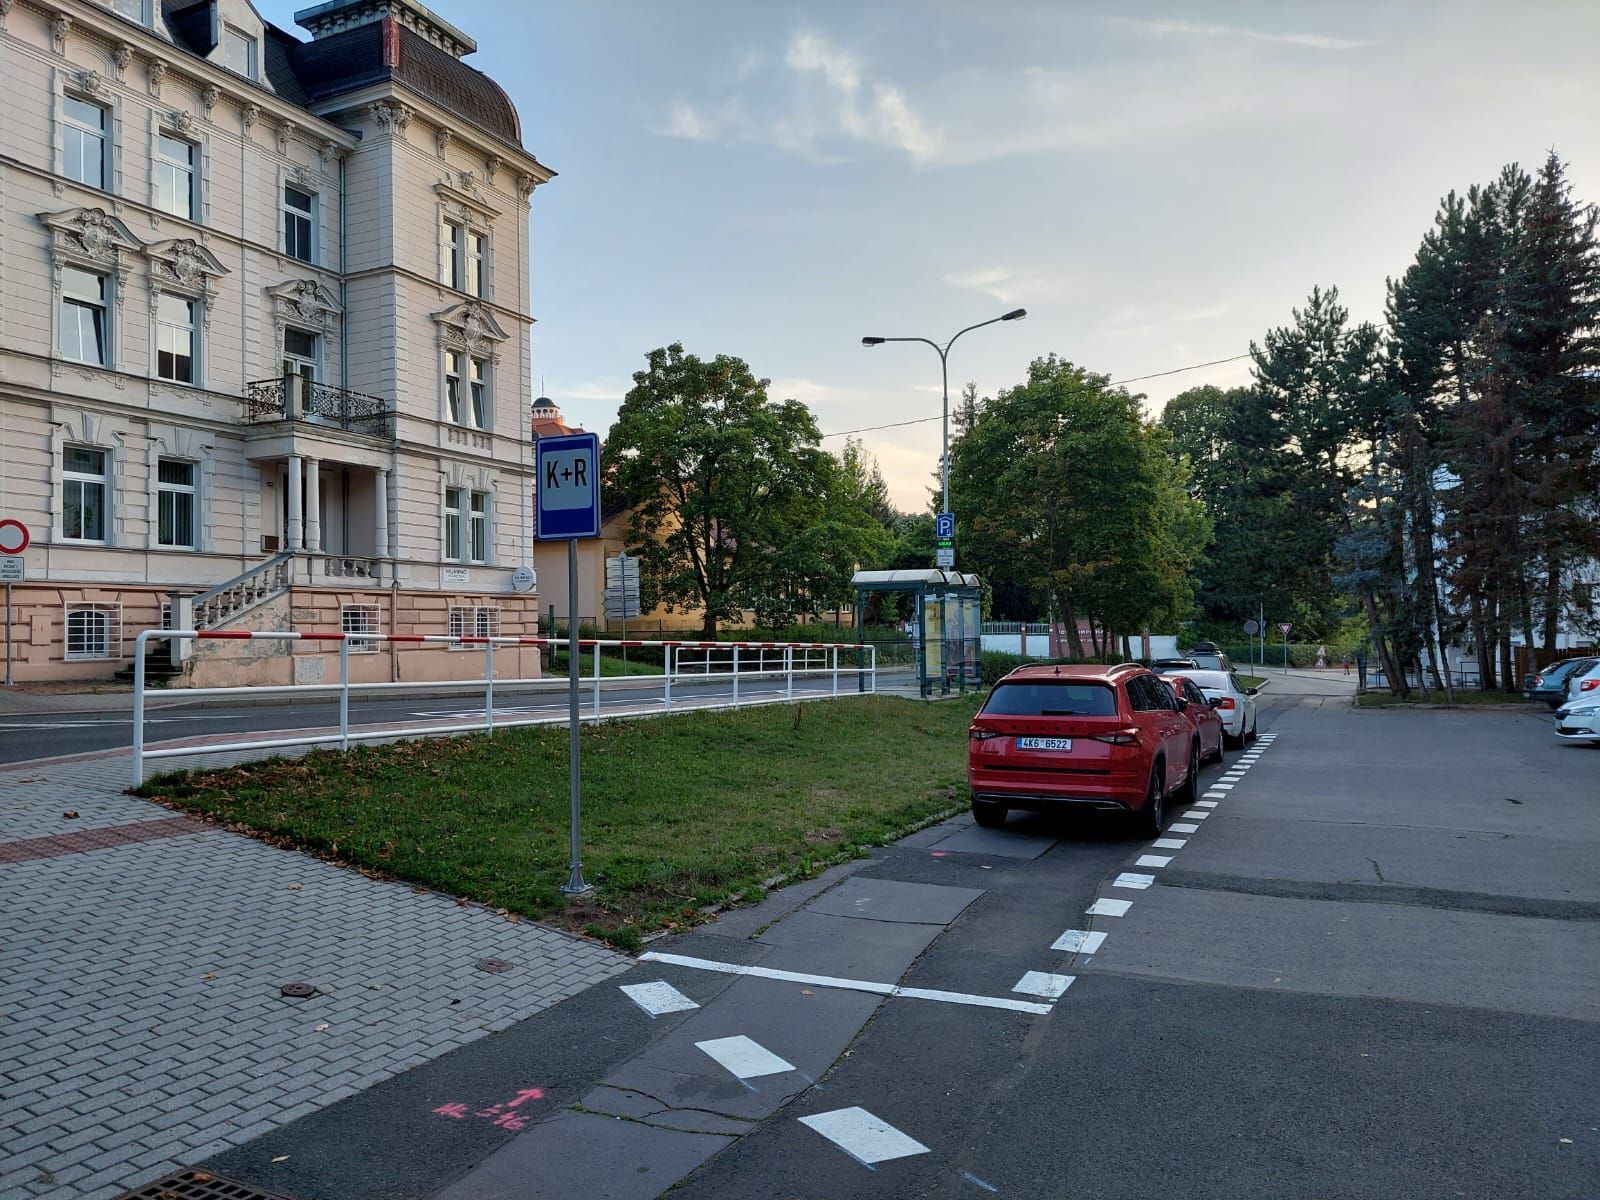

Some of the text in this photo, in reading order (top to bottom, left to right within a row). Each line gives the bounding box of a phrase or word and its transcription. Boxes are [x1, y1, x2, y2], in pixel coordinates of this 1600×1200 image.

[547, 458, 587, 488] K+R
[940, 520, 950, 535] P
[1023, 739, 1068, 749] 4K6 6522
